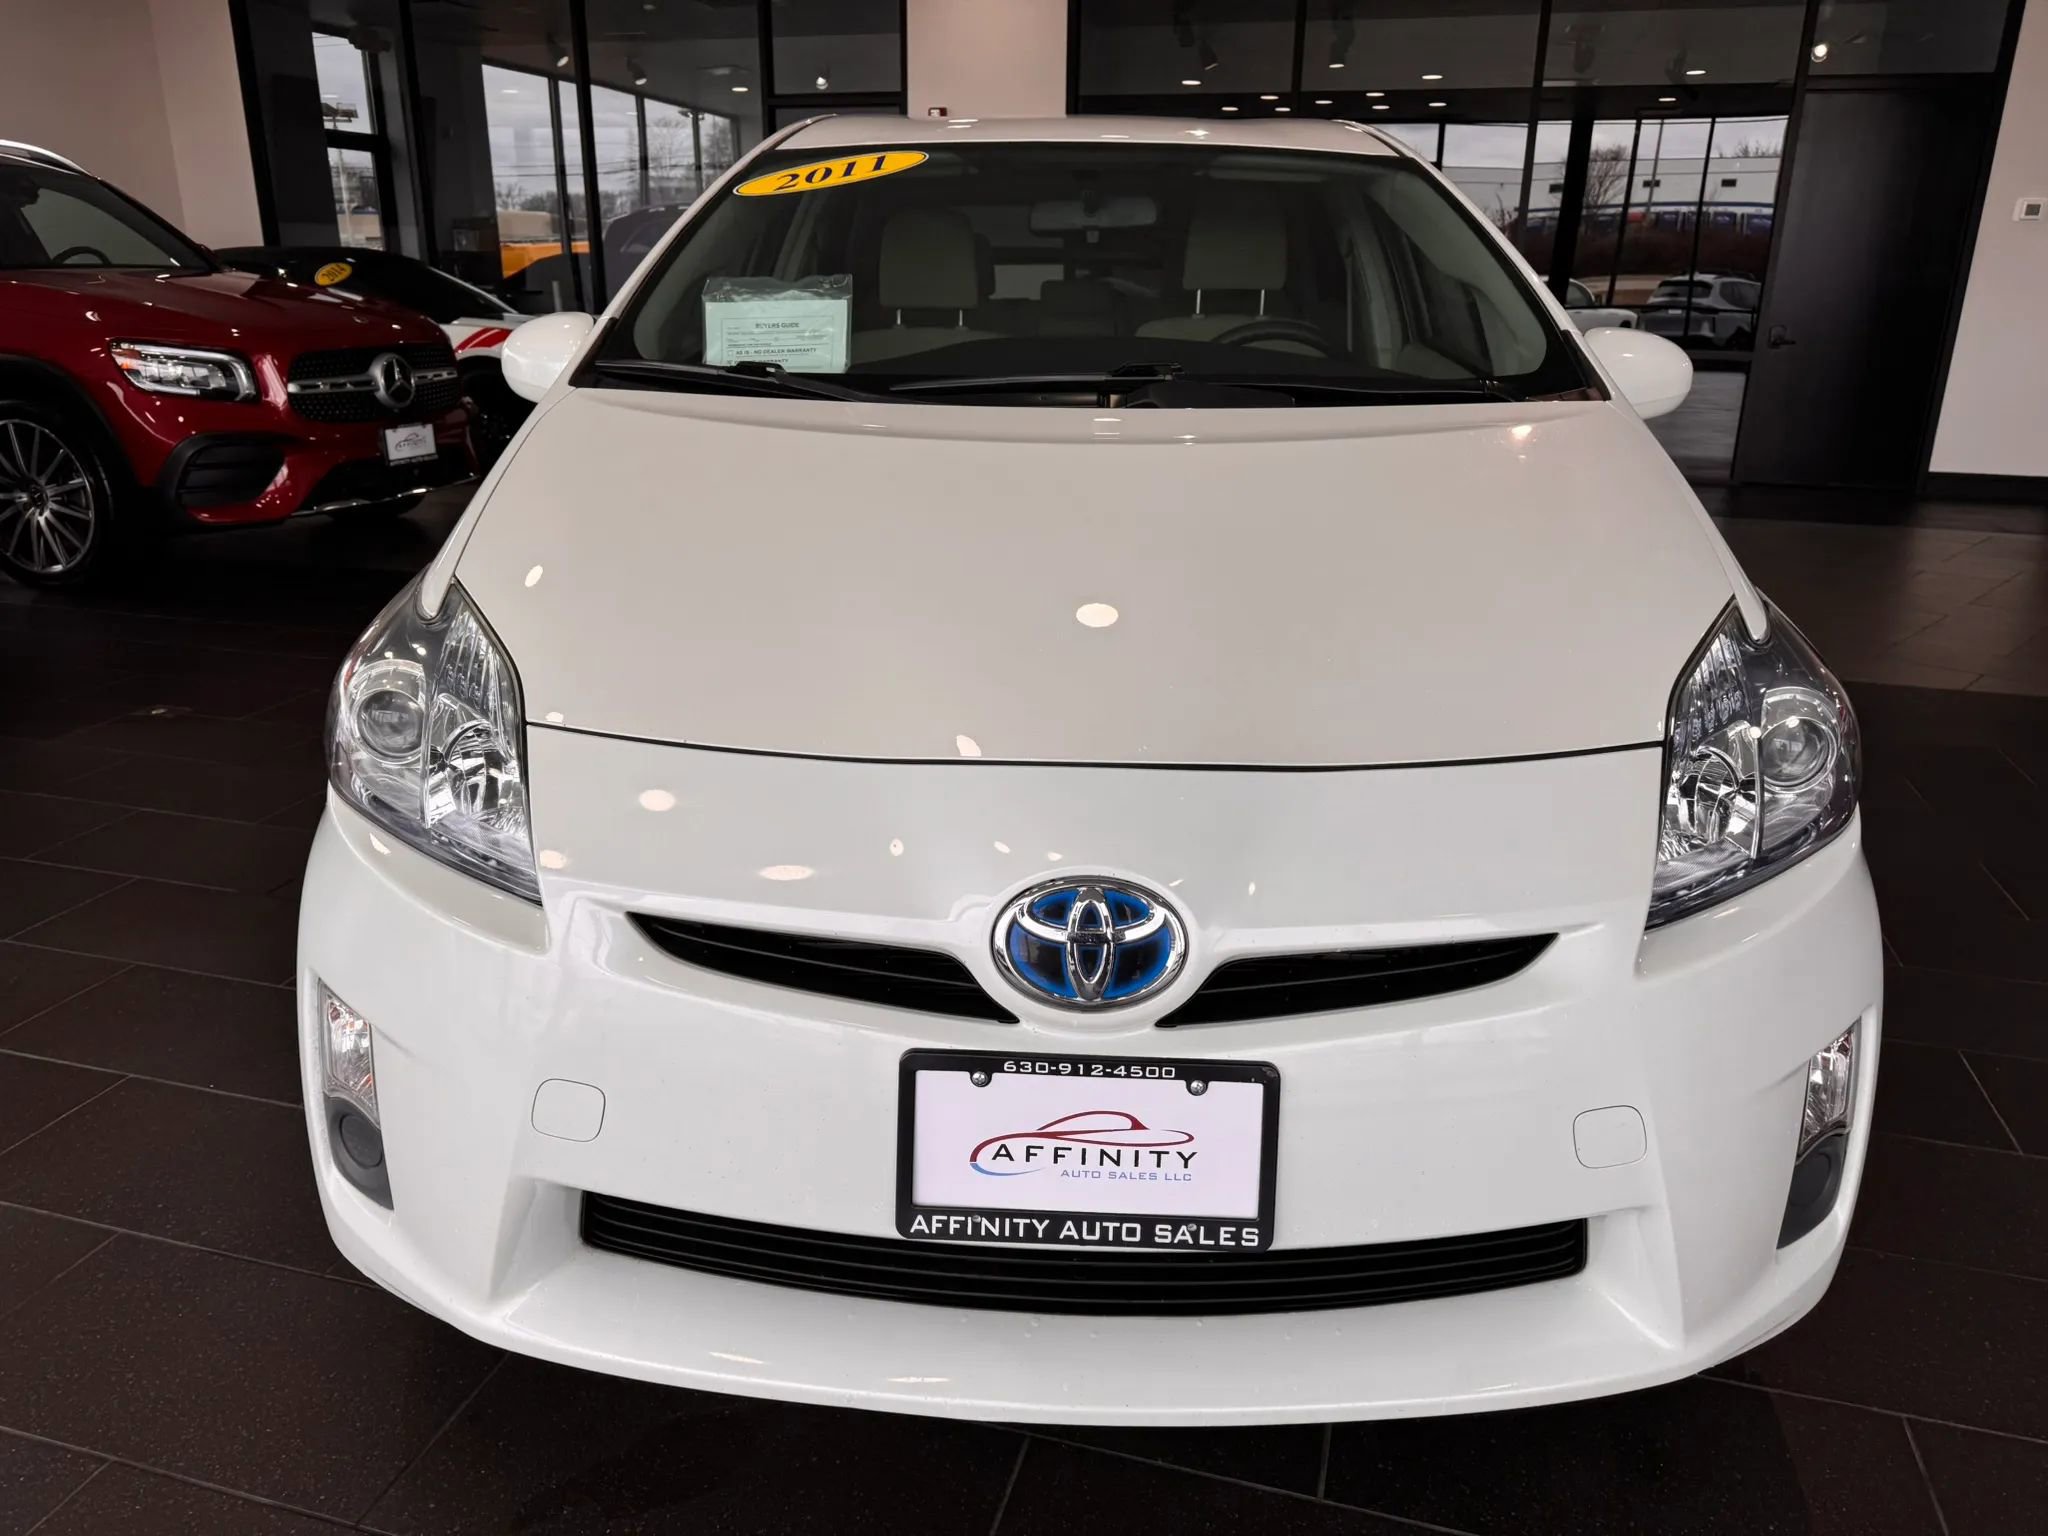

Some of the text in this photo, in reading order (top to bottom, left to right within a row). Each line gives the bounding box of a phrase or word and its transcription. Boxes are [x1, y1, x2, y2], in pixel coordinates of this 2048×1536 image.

[774, 155, 887, 192] 2011
[1003, 1060, 1176, 1079] 630-912-4500
[991, 1143, 1198, 1169] AFFINITY
[1060, 1169, 1192, 1182] AUTO SALES LLC
[910, 1214, 1259, 1247] AFFINITY AUTO SALES
